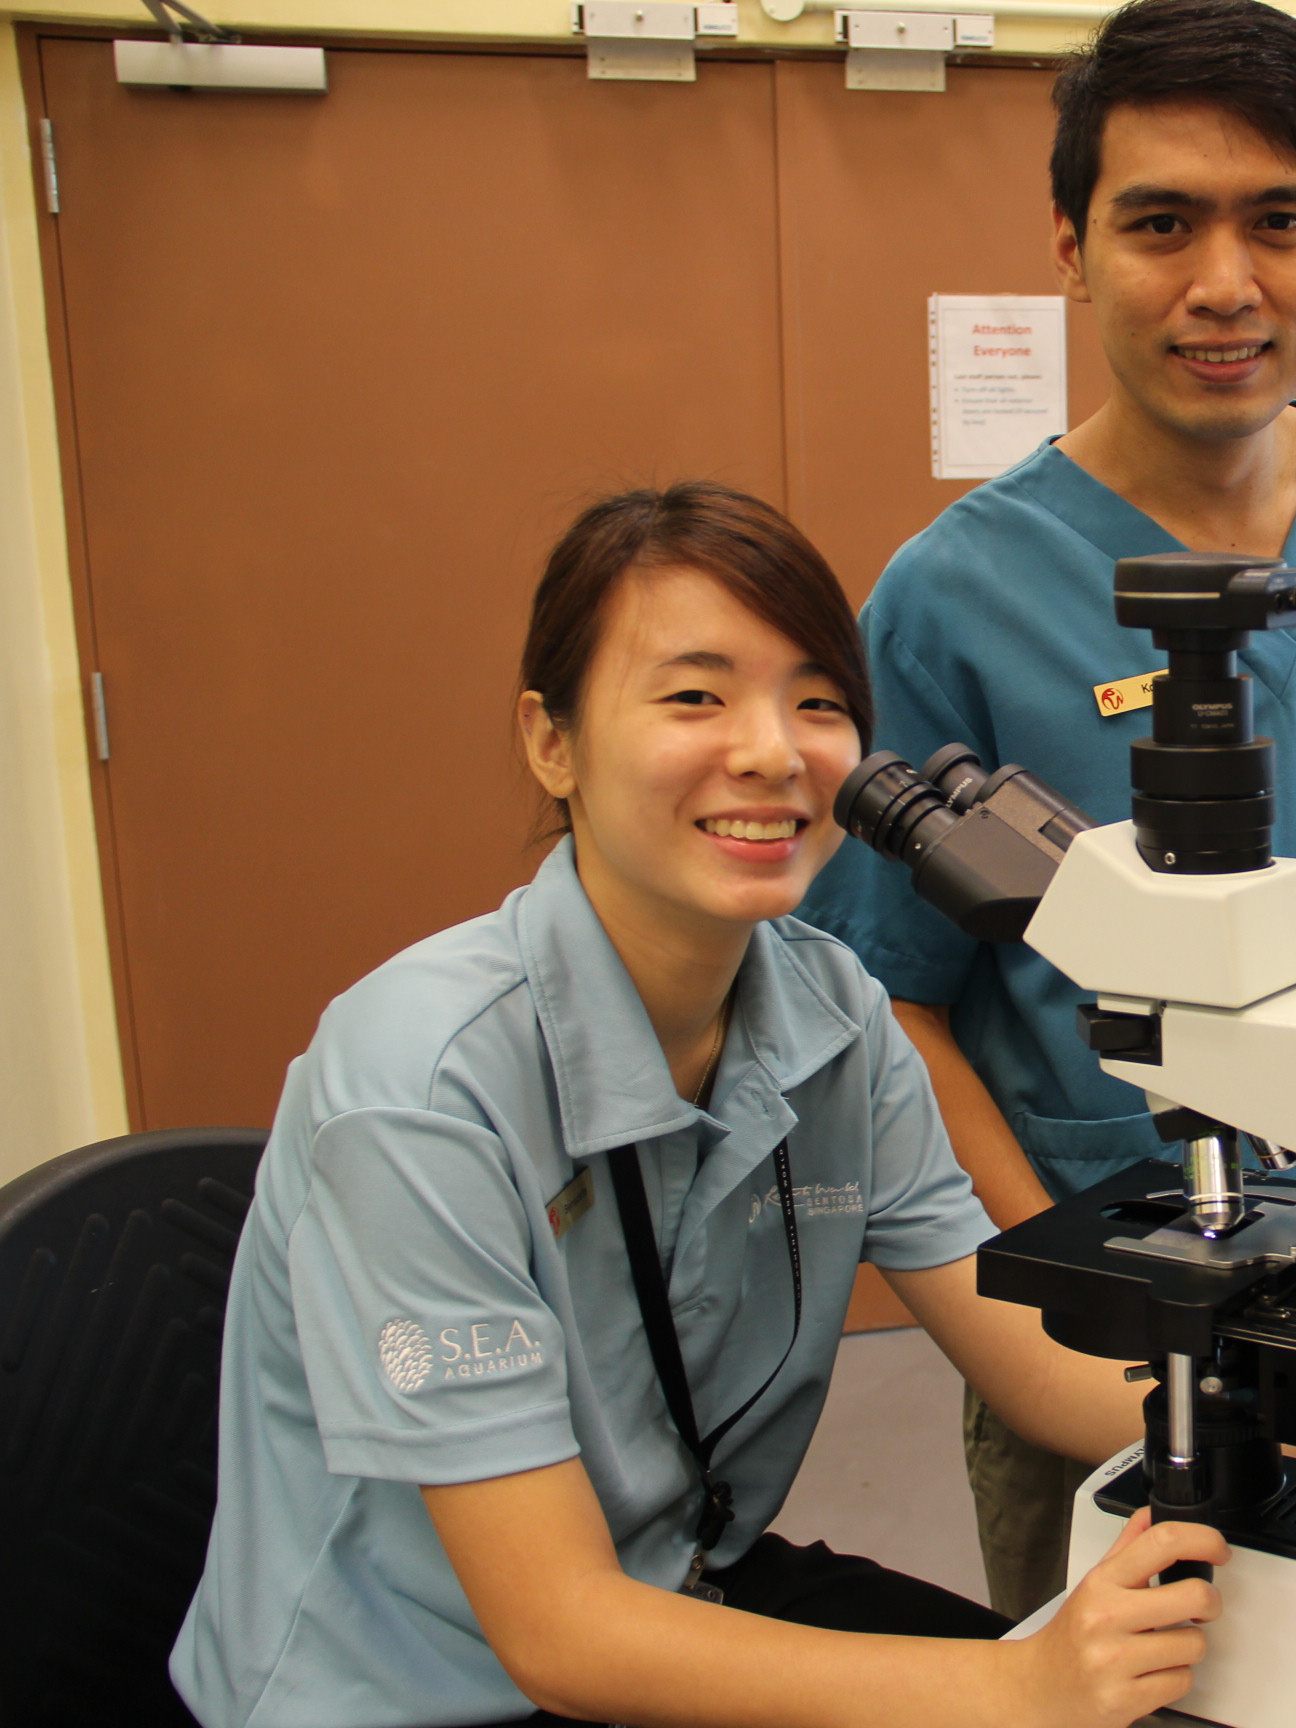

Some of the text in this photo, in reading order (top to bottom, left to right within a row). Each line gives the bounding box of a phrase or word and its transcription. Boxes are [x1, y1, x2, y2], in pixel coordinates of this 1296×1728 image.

[972, 324, 1032, 335] Attention
[973, 345, 1032, 358] Everyone
[1192, 703, 1233, 711] OLYMPUS
[946, 777, 973, 808] LYMPUS
[806, 1194, 863, 1206] SENTOSA
[807, 1204, 864, 1216] SINGAPORE
[440, 1319, 541, 1362] S.E.A.
[444, 1352, 543, 1380] AQUARIUM
[1104, 1446, 1145, 1476] LYMPUS
